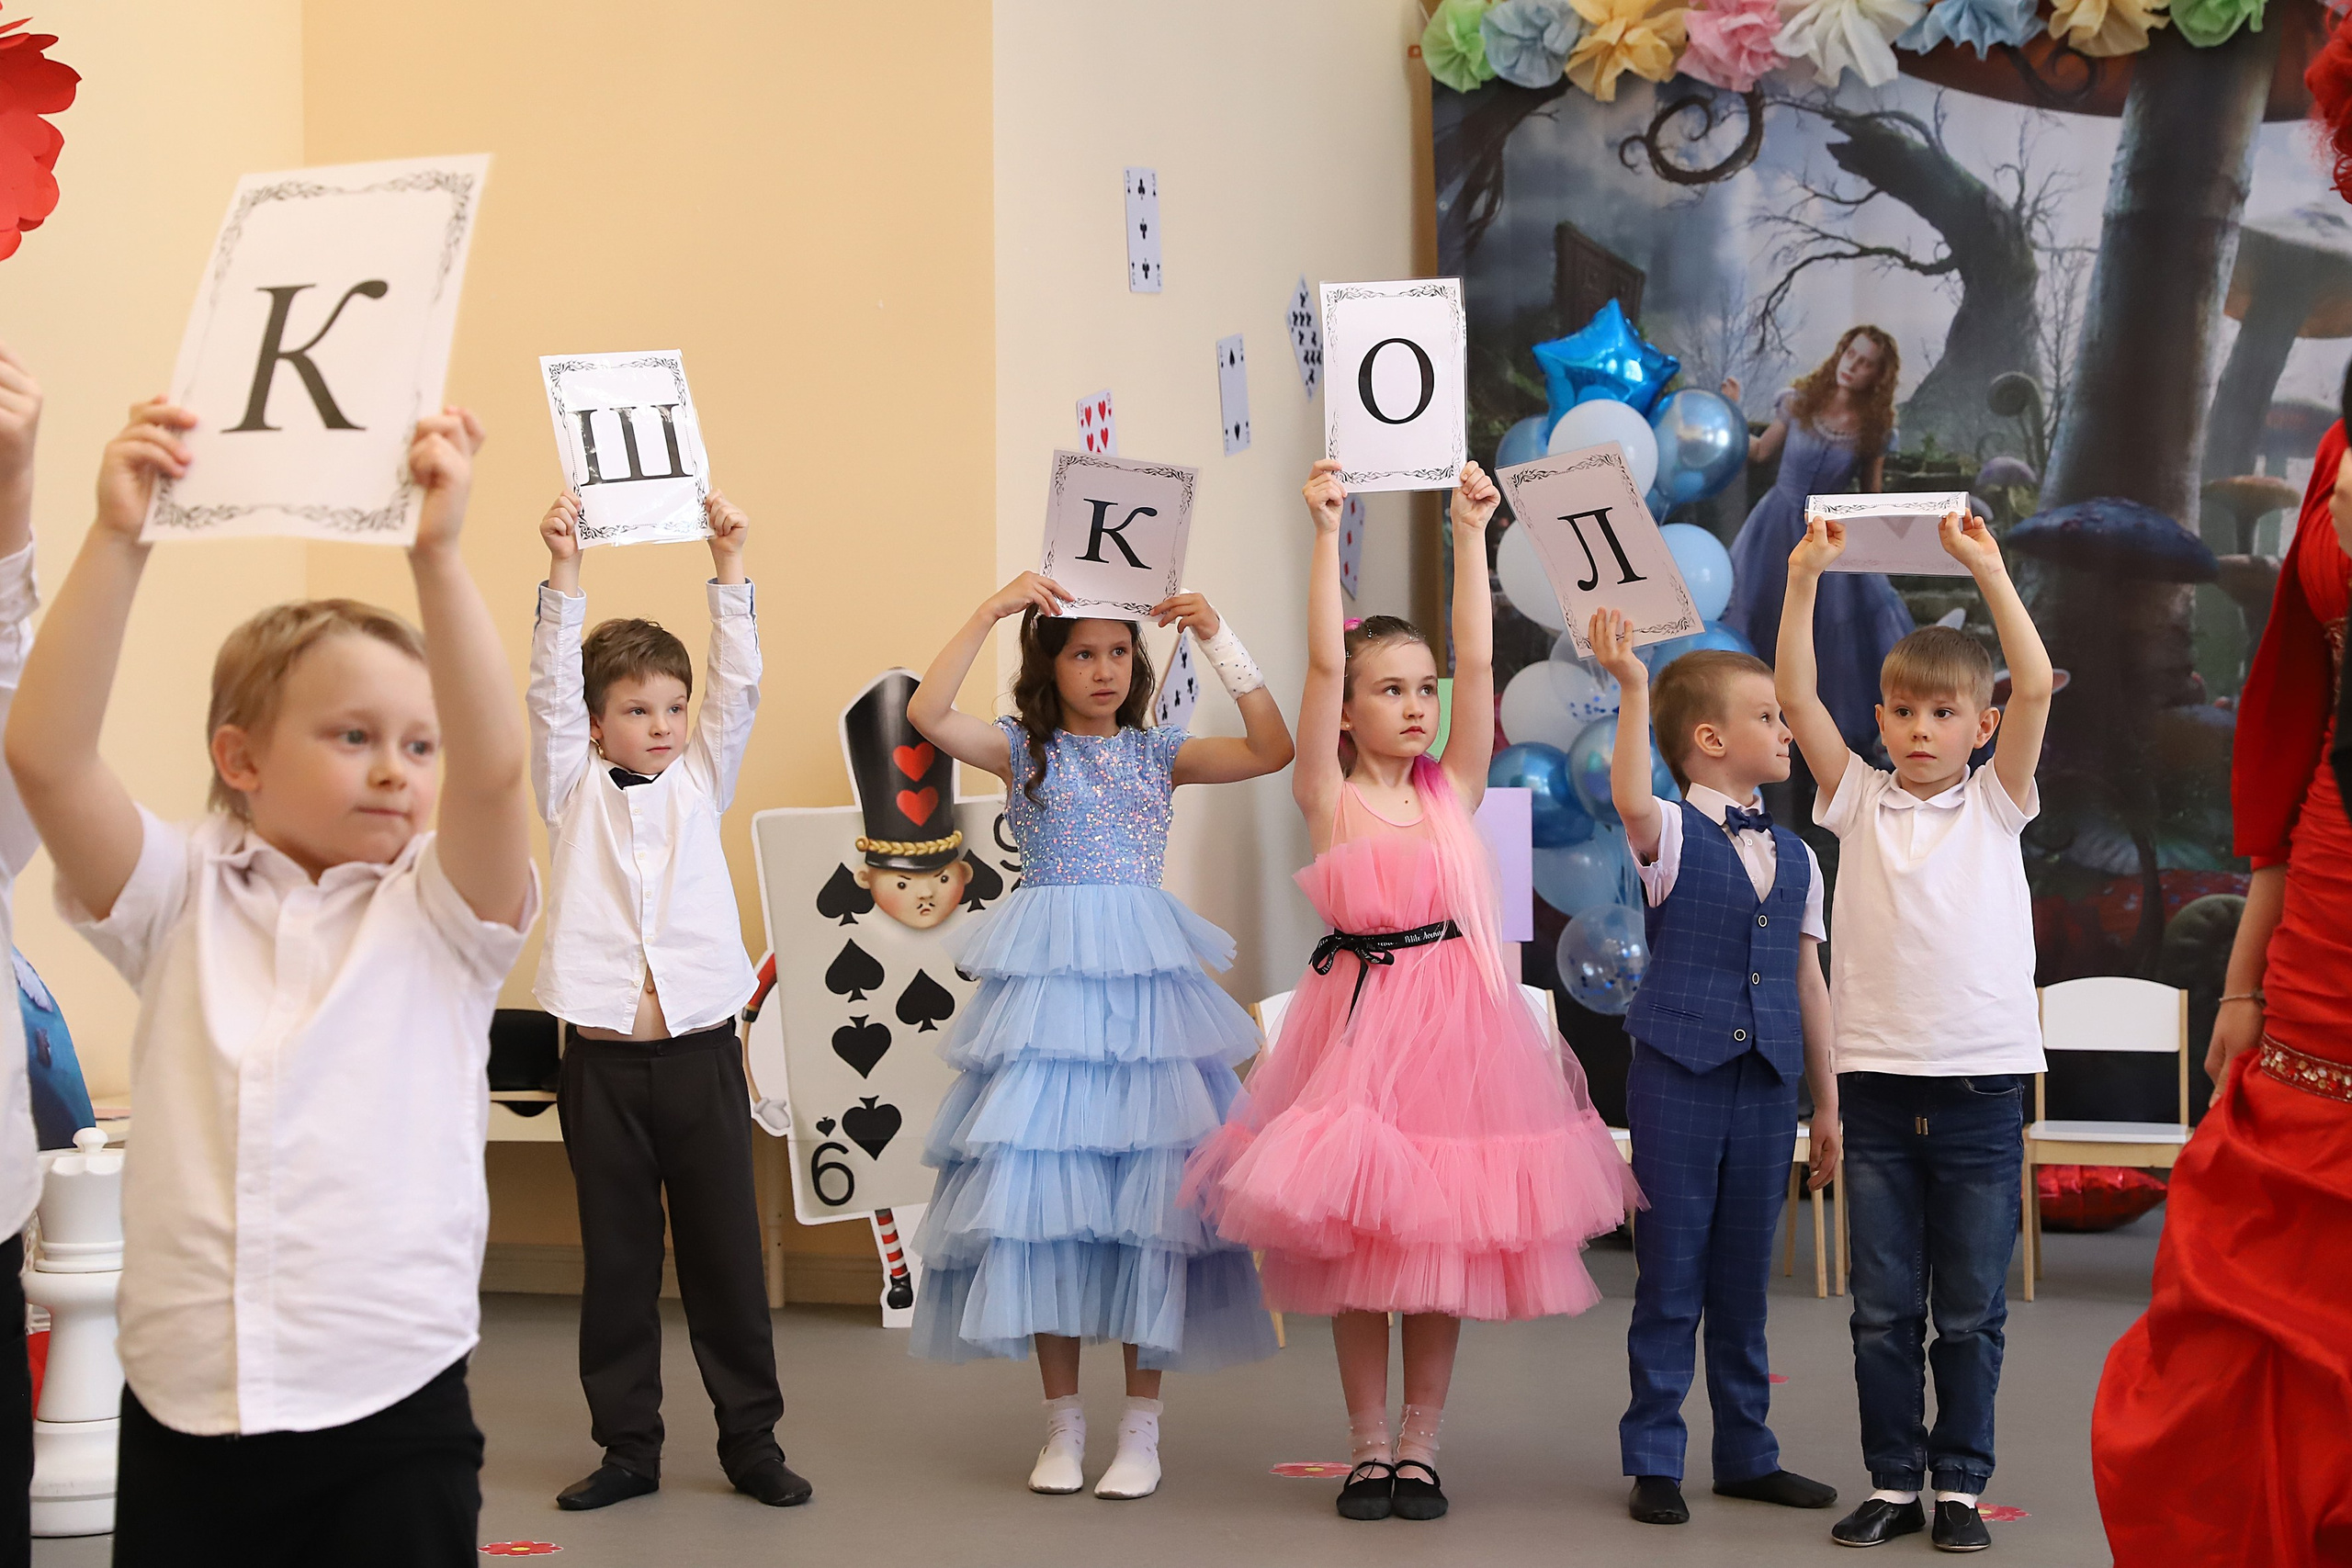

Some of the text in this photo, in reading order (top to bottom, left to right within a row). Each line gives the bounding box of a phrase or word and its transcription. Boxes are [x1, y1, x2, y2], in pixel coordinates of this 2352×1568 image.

[221, 280, 389, 434] К
[1358, 337, 1435, 425] О
[568, 402, 695, 489] Ш
[1074, 498, 1159, 570] К
[1556, 506, 1648, 592] Л
